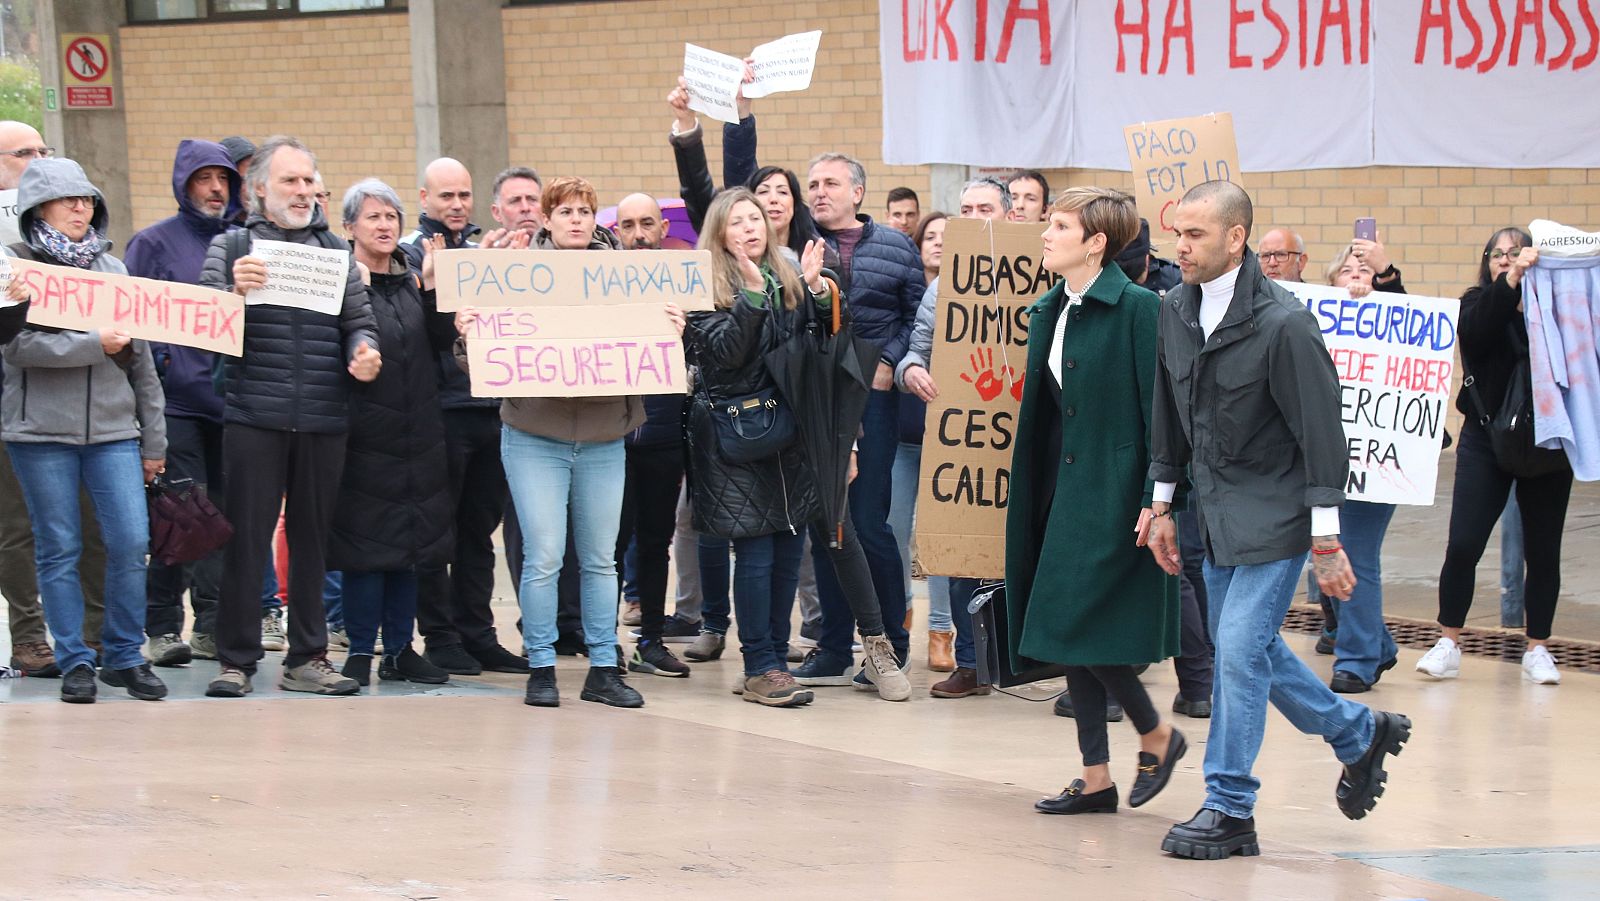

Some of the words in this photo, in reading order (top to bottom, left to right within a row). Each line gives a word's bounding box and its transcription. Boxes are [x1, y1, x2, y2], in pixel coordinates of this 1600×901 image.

[1114, 0, 1194, 75] HA
[1132, 127, 1196, 159] PACO
[1146, 162, 1187, 196] FOT
[457, 261, 554, 296] PACO
[475, 308, 538, 339] MÉS
[485, 342, 677, 388] SEGURETAT
[1329, 348, 1379, 382] EDE
[1384, 355, 1452, 395] HABER
[938, 407, 1013, 450] CES
[932, 462, 1010, 509] CALD
